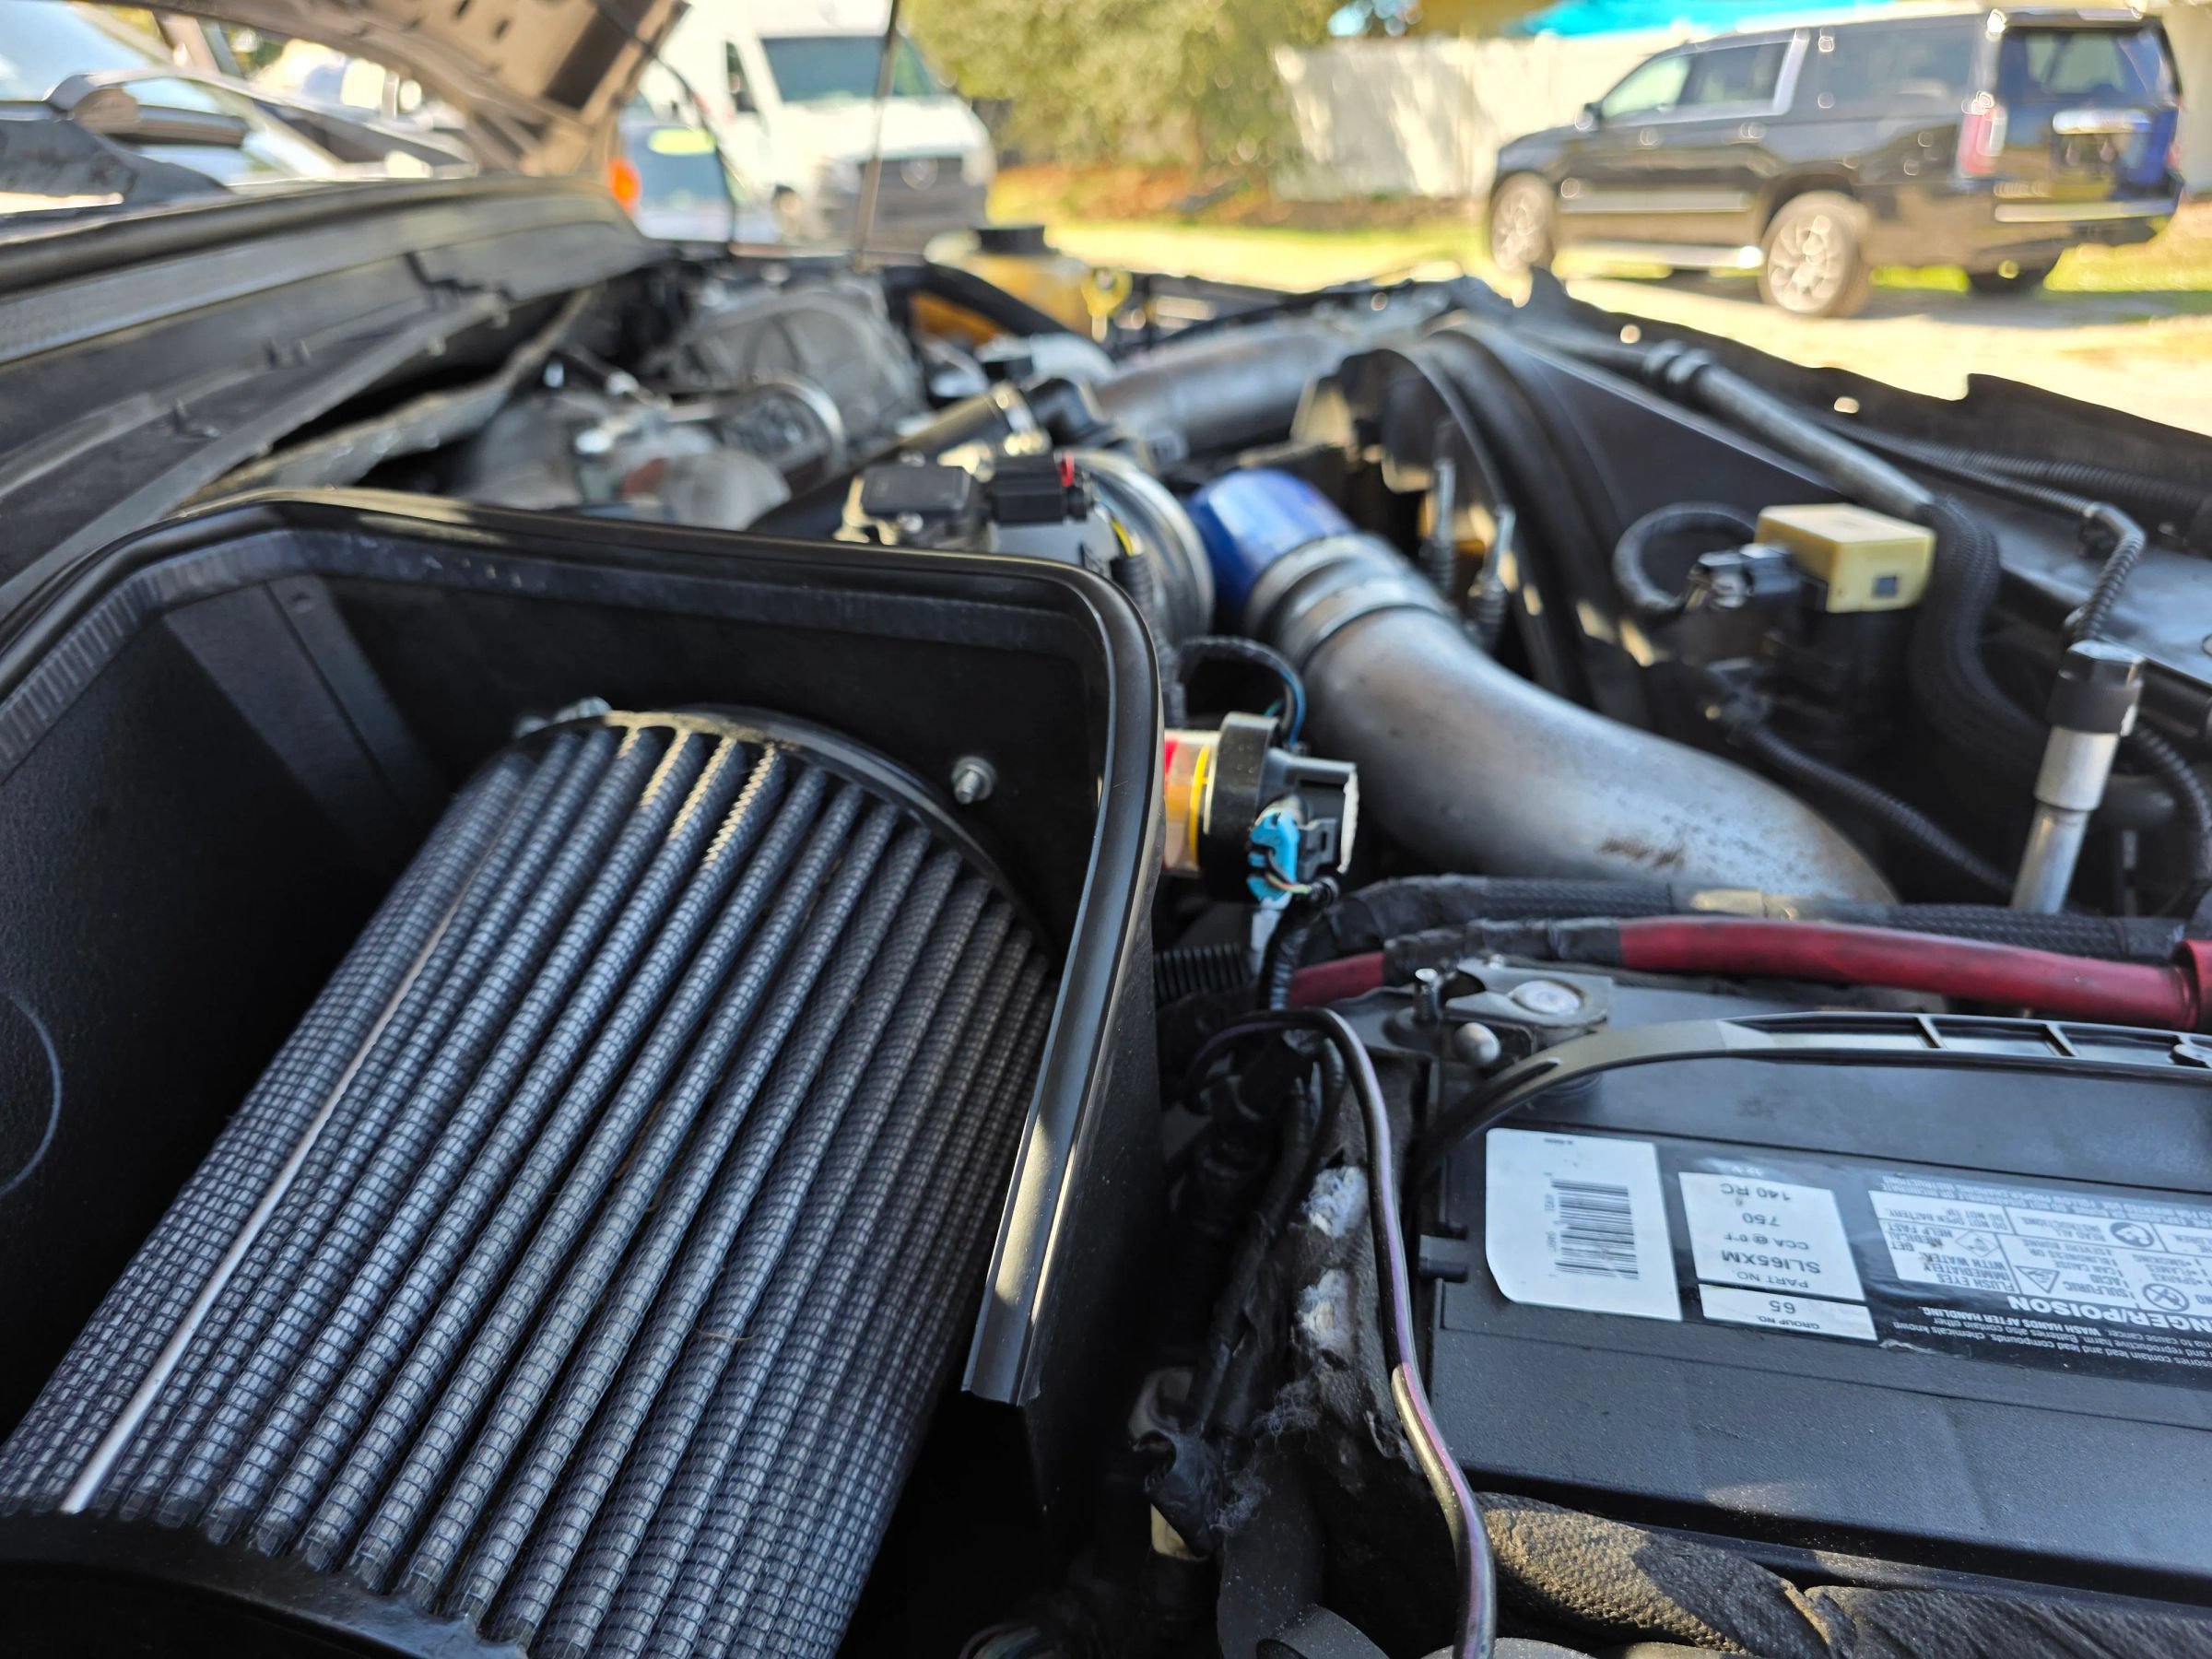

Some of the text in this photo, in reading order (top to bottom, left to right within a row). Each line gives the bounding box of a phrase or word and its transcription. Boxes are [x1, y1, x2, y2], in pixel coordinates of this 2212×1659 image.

[1718, 1182, 1791, 1202] 140 RC
[1742, 1212, 1781, 1228] 750
[1751, 1233, 1770, 1244] @
[1922, 1227, 1953, 1239] HELP
[1773, 1238, 1809, 1250] CCA
[1889, 1241, 1914, 1252] GET
[1721, 1250, 1821, 1274] SLI65XM
[1971, 1258, 2006, 1270] WITH
[1923, 1263, 2011, 1281] IMMEDIATELY
[1732, 1270, 1808, 1288] PART NO.
[1936, 1274, 2015, 1292] FLUSH EYES
[2089, 1274, 2120, 1287] ACID
[2063, 1281, 2129, 1299] SULFURIC
[1769, 1300, 1795, 1314] 65
[1917, 1307, 1982, 1322] HANDLING.
[1983, 1314, 2020, 1326] AFTER
[2007, 1296, 2212, 1333] NGER/POISON
[1755, 1314, 1819, 1331] GROUP NO.
[1893, 1322, 1930, 1333] known
[1933, 1317, 1961, 1328] other
[1963, 1321, 2004, 1333] contain
[2022, 1319, 2063, 1332] HANDS
[1931, 1325, 1985, 1340] chemicals
[2006, 1325, 2027, 1336] also
[2030, 1329, 2077, 1342] Batteries
[2065, 1324, 2101, 1336] WASH
[2145, 1335, 2178, 1344] cause
[2181, 1338, 2194, 1347] to
[2194, 1340, 2212, 1349] nia
[2055, 1342, 2079, 1353] lead
[2081, 1346, 2103, 1354] and
[2114, 1339, 2183, 1355] reproductive
[2105, 1348, 2129, 1359] lead
[2131, 1351, 2171, 1363] contain
[2184, 1349, 2206, 1359] and
